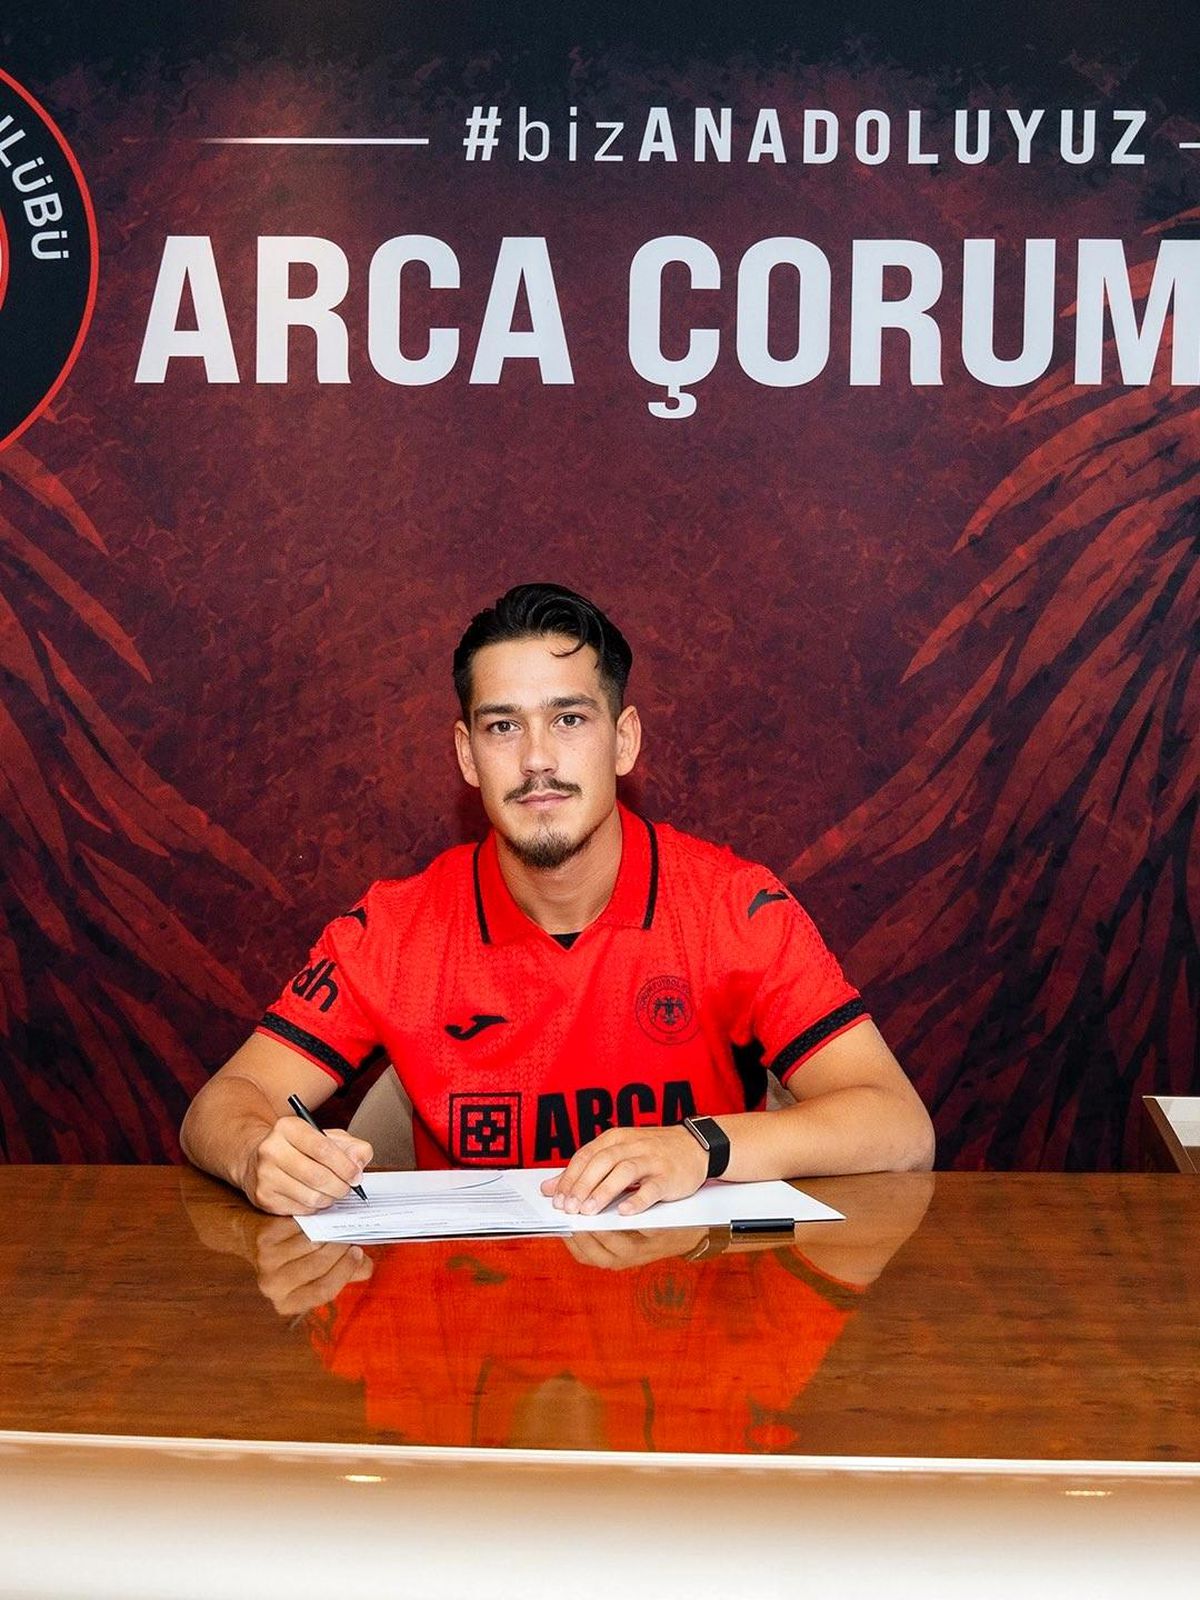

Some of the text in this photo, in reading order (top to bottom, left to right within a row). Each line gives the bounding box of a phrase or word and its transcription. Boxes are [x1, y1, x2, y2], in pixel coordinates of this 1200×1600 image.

[462, 106, 1147, 165] #bizANADOLUYUZ
[134, 235, 1200, 419] ARCA ÇORUM
